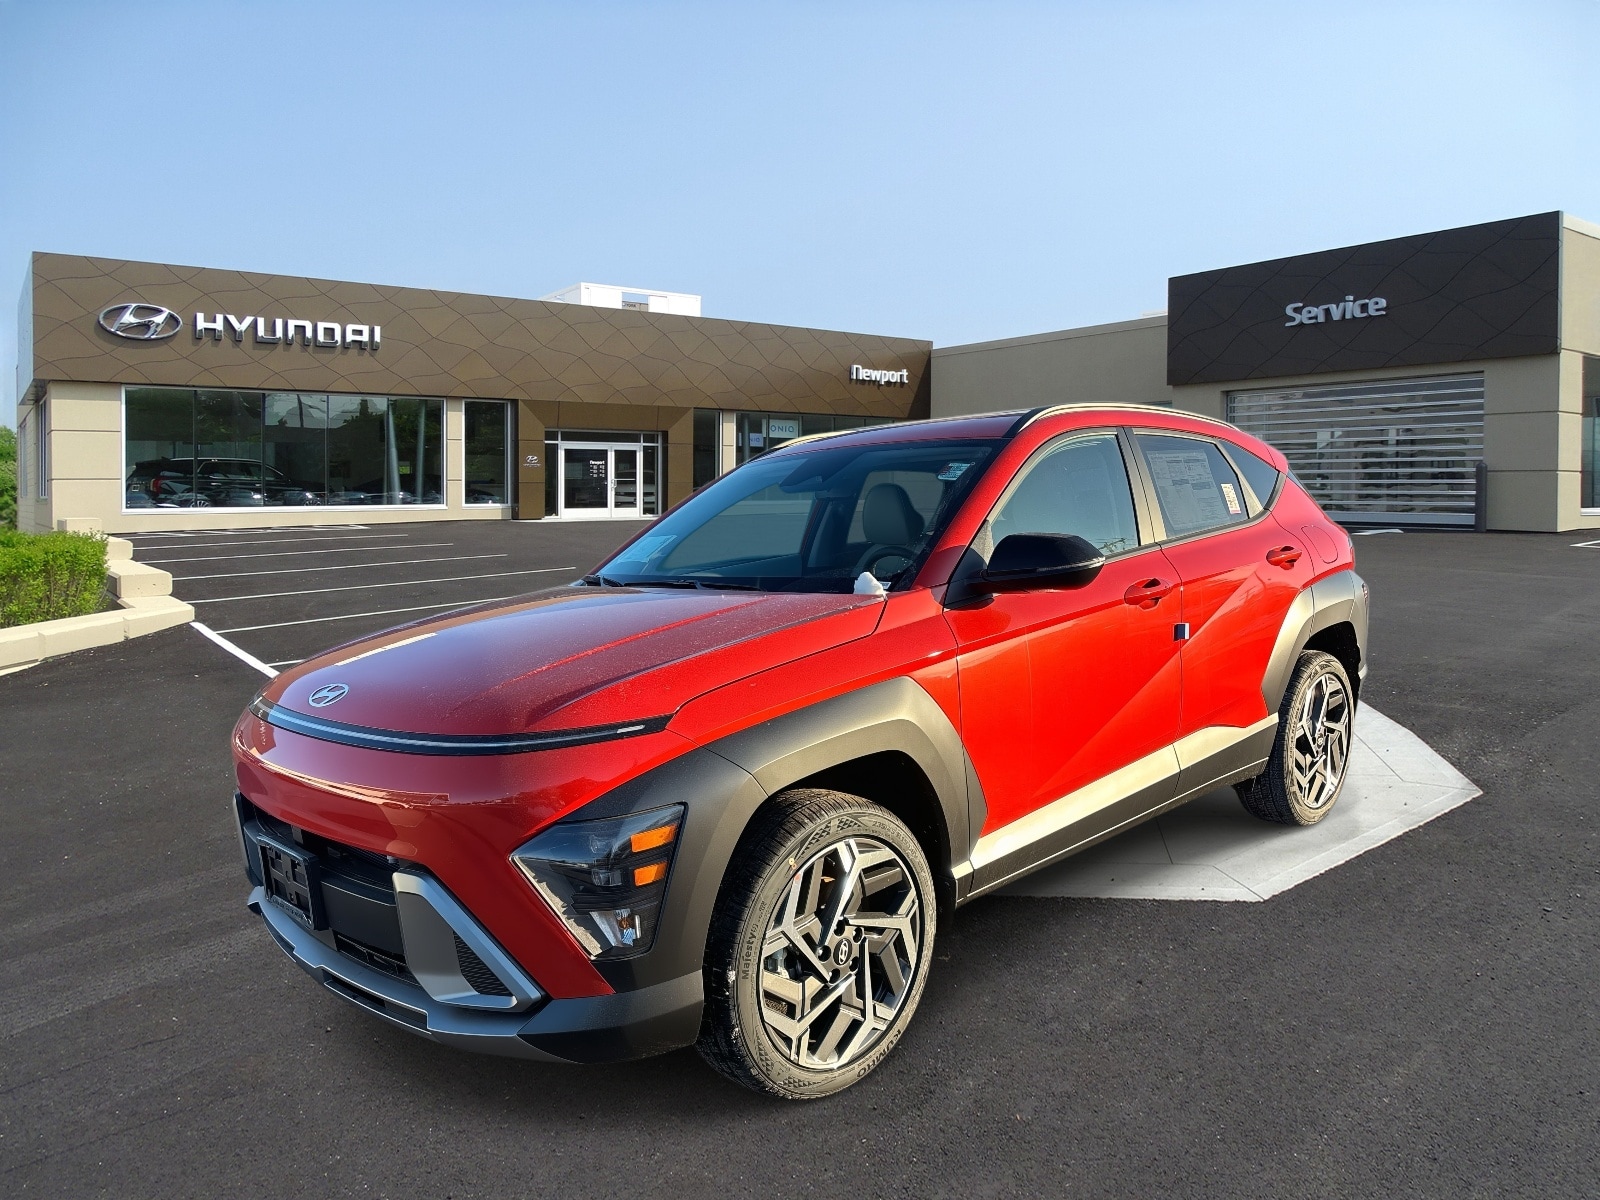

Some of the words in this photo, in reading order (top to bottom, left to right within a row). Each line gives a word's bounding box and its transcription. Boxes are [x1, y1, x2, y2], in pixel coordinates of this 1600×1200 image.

[1285, 295, 1387, 327] Service
[195, 312, 381, 351] HYUNDAI
[851, 364, 908, 385] Newport
[857, 1029, 901, 1077] KUMHO
